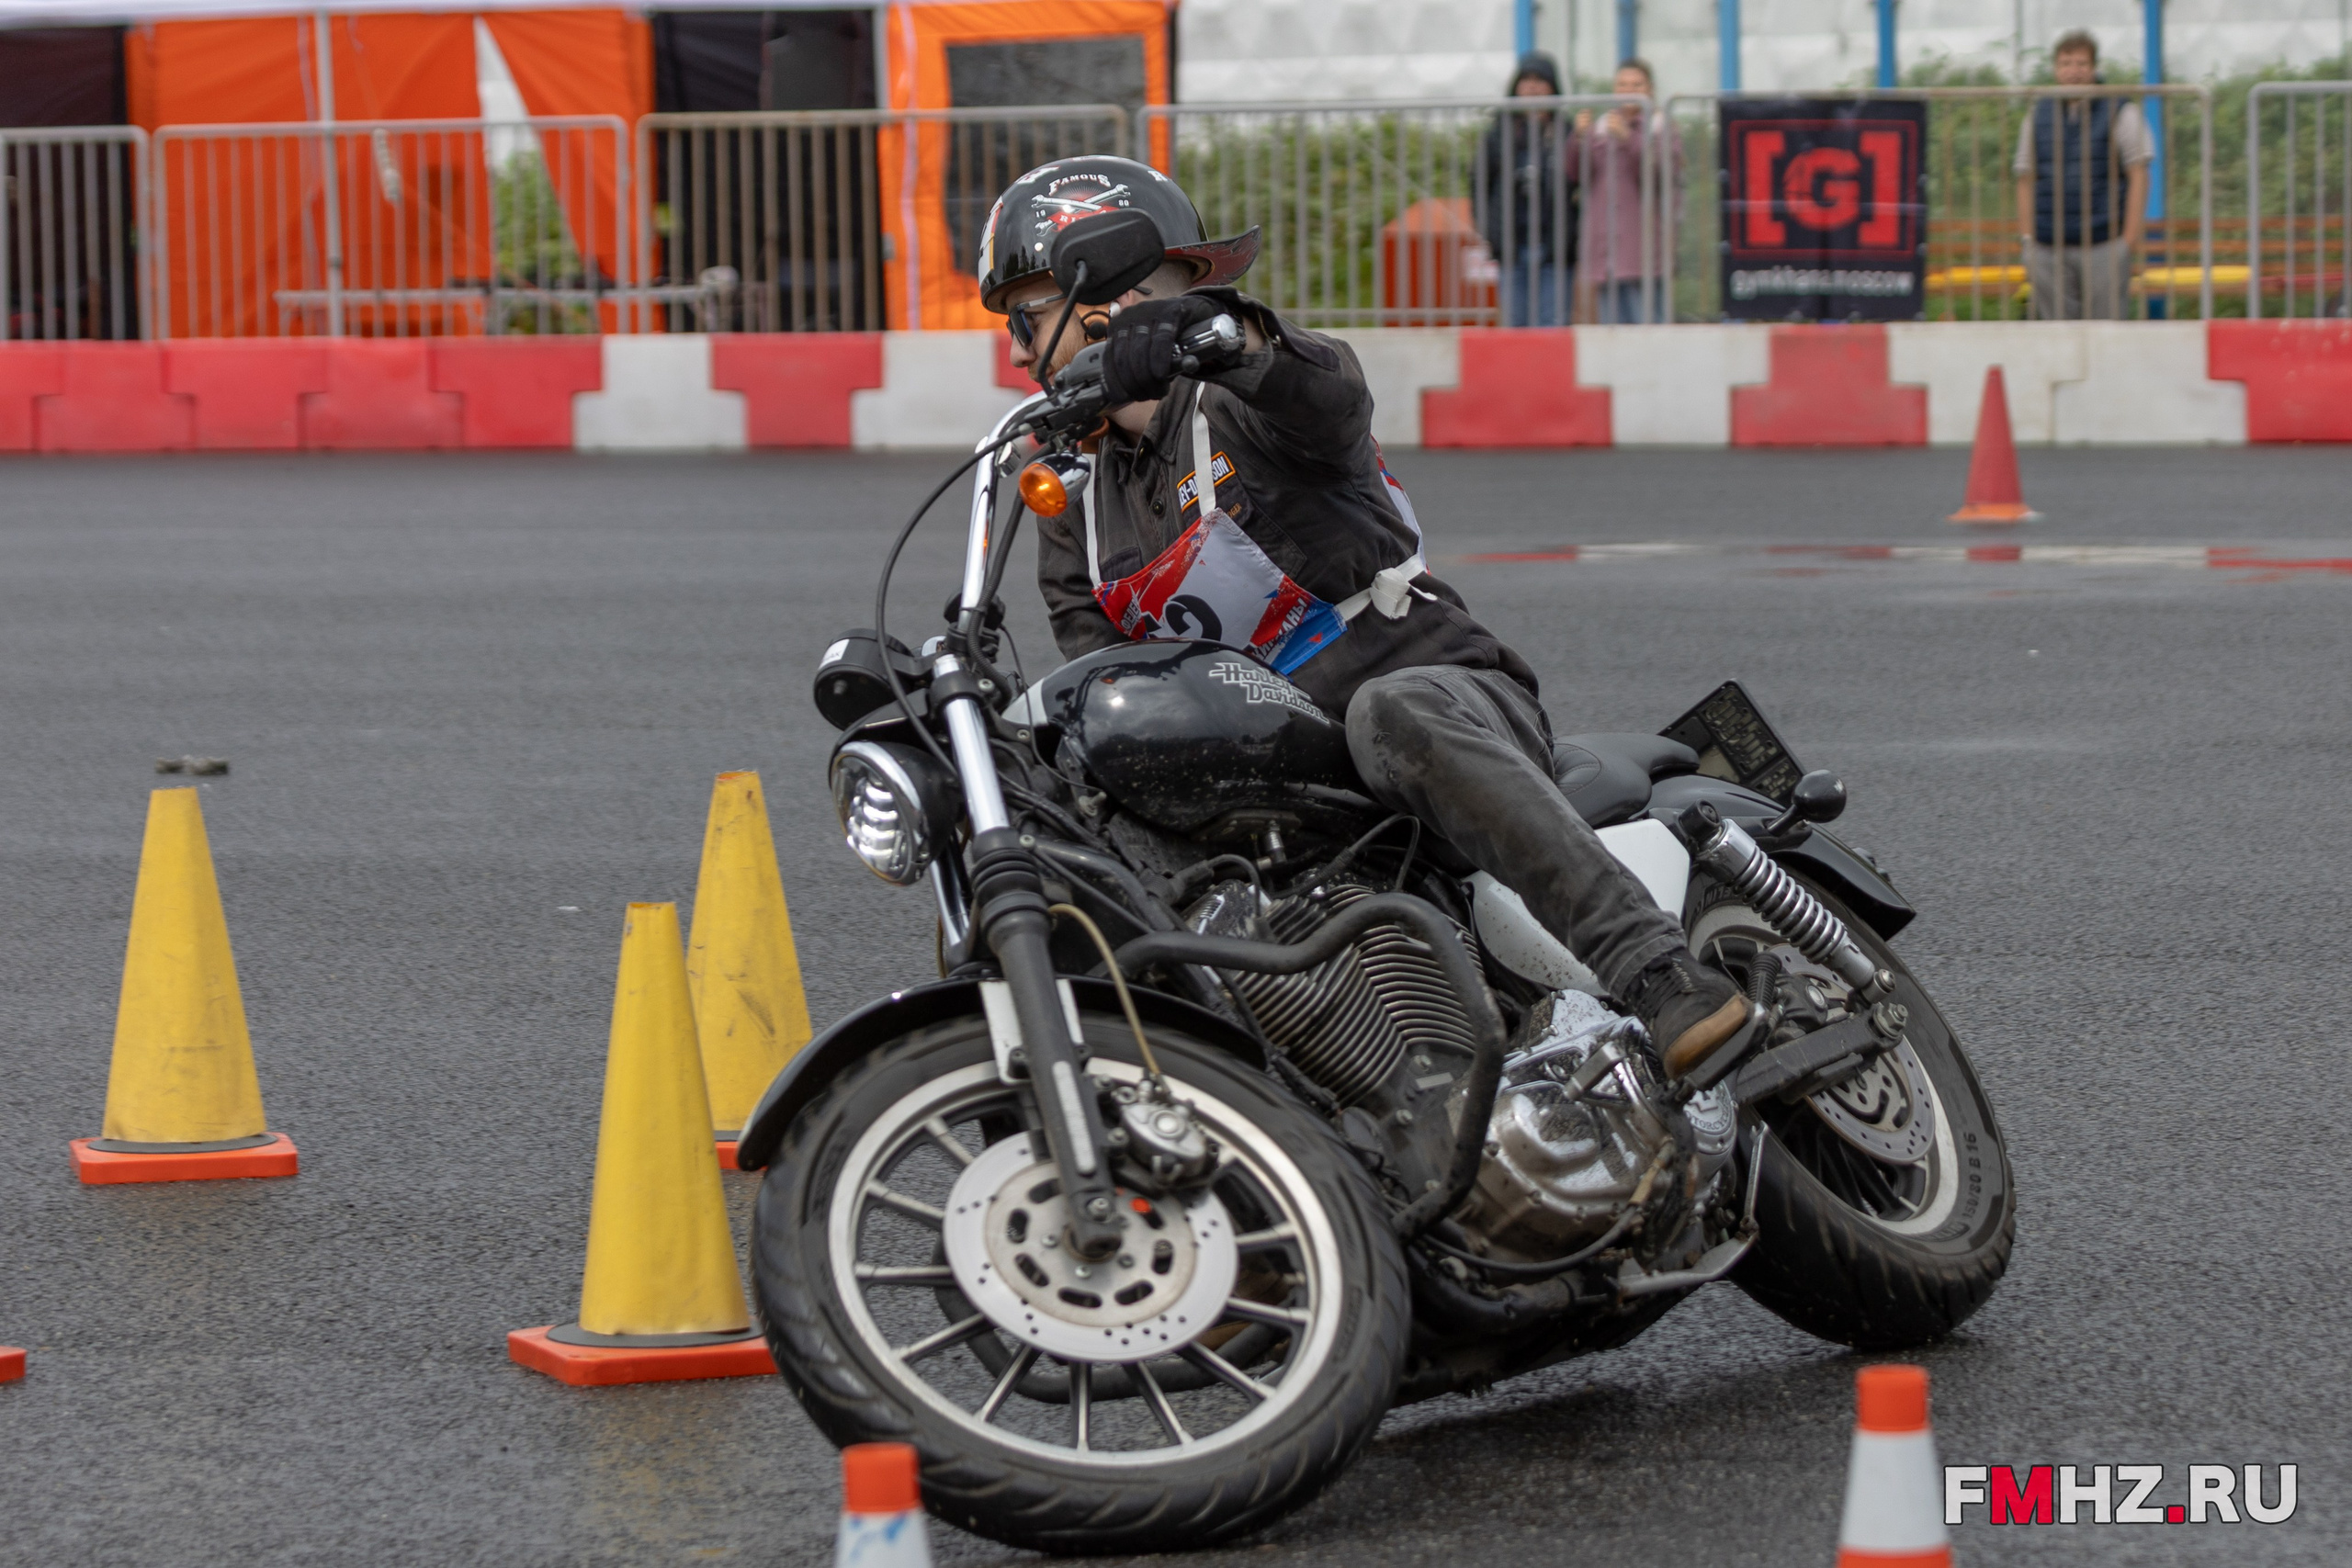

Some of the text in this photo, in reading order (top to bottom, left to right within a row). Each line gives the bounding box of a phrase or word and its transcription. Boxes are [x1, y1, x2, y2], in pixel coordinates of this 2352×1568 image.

[1048, 174, 1112, 197] FAMOUS
[1035, 209, 1046, 219] 19
[1209, 662, 1312, 702] Harley
[1240, 682, 1330, 727] Davidson
[1963, 1131, 1979, 1152] 16
[1969, 1157, 1981, 1168] B
